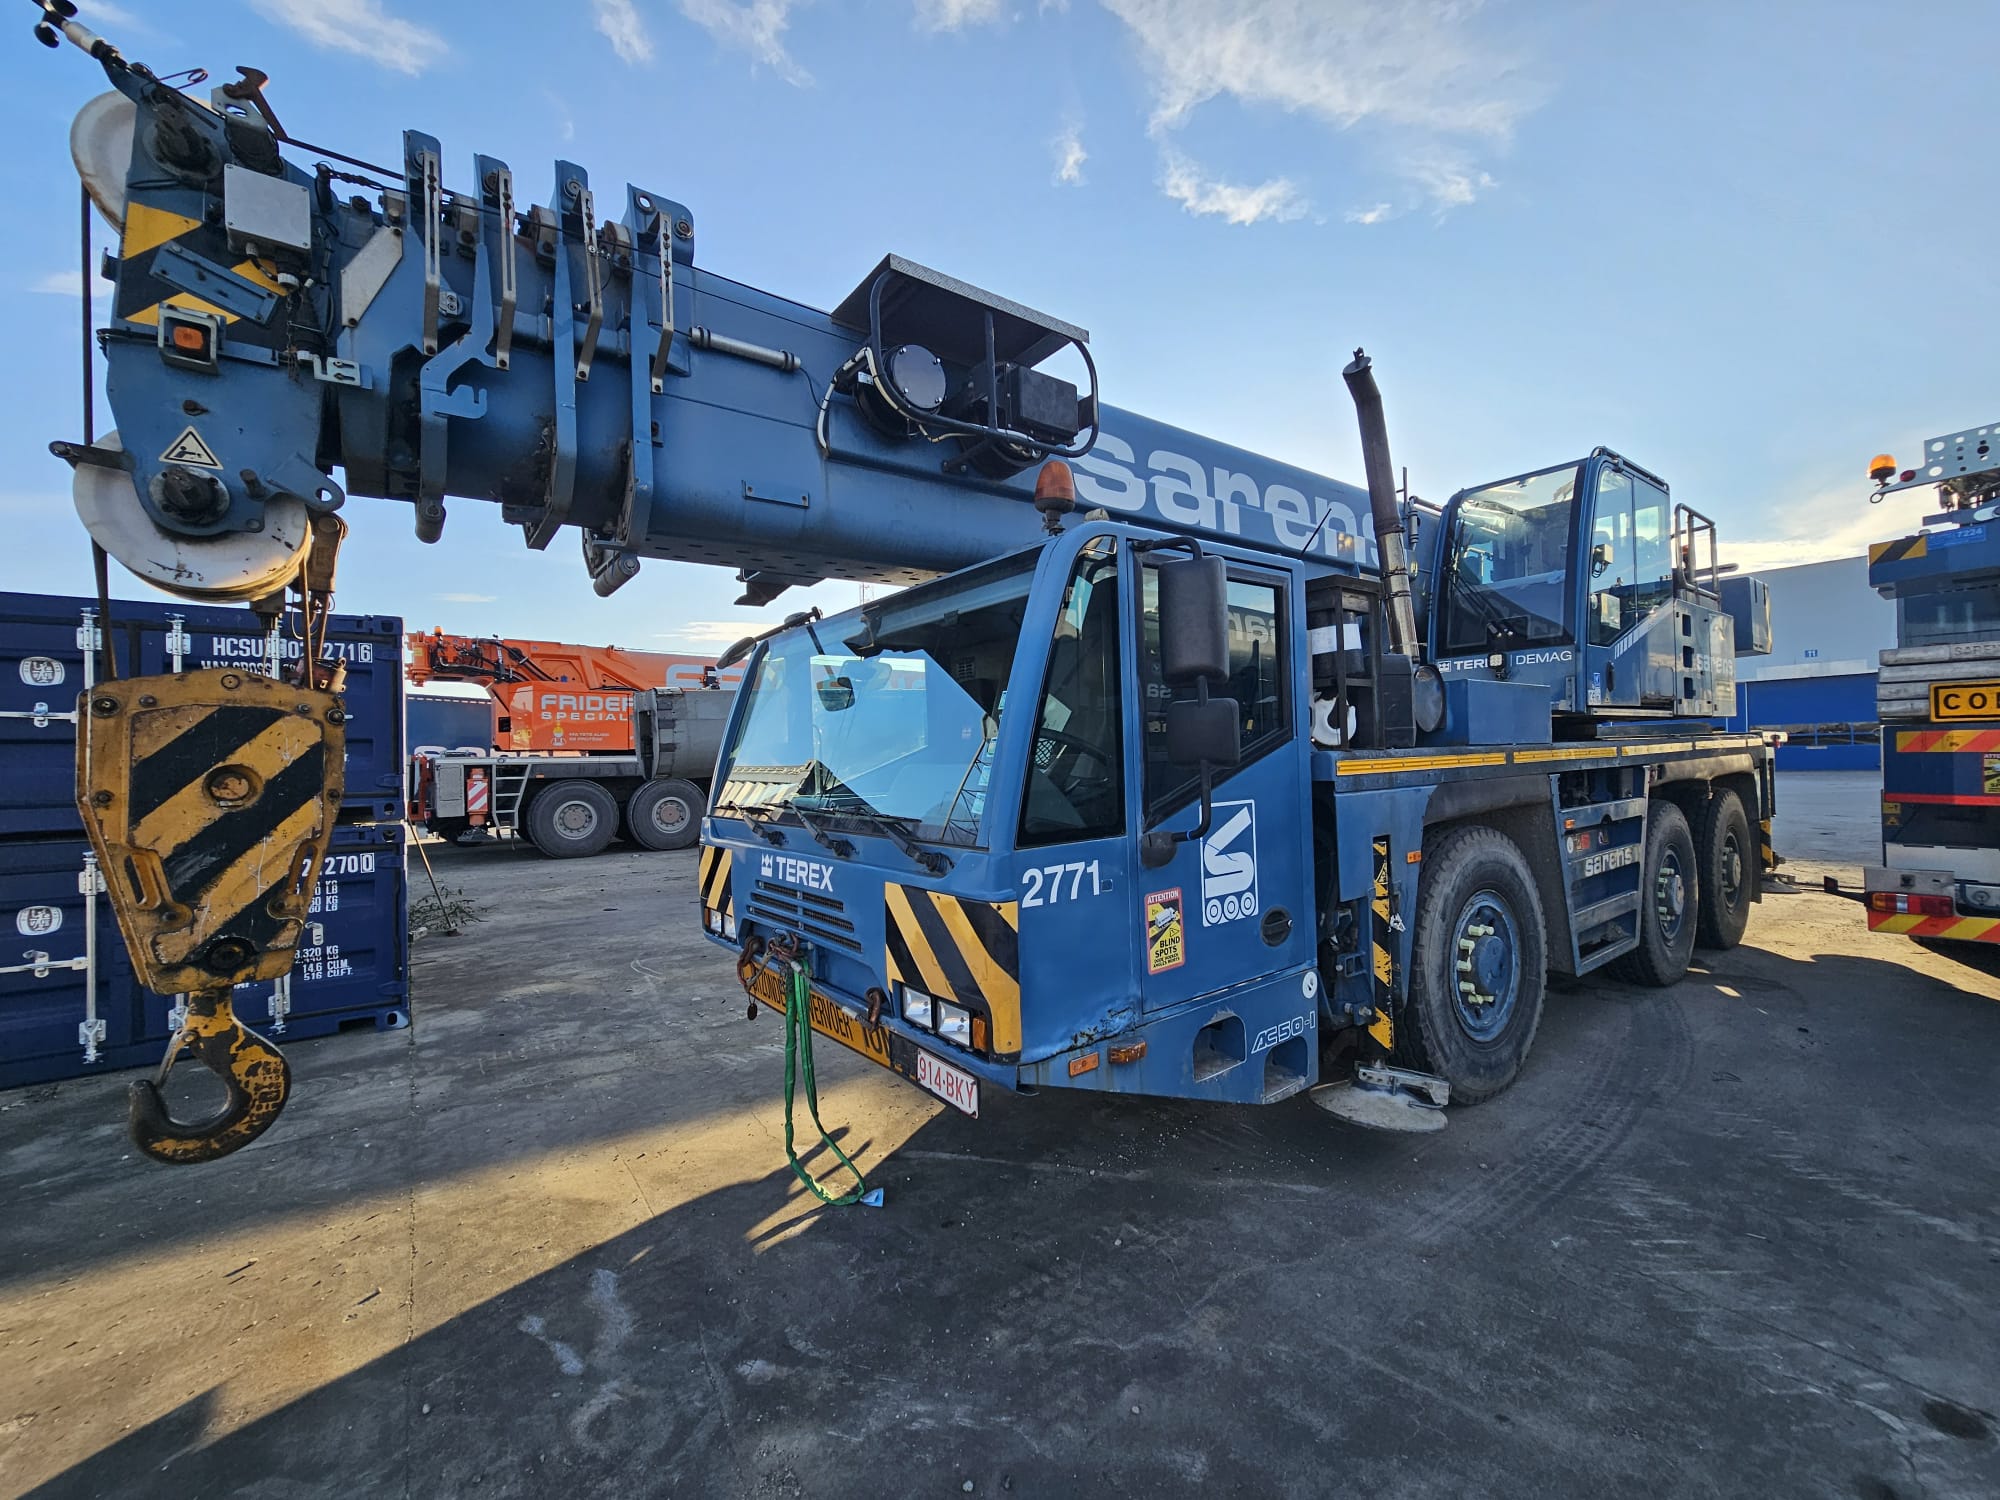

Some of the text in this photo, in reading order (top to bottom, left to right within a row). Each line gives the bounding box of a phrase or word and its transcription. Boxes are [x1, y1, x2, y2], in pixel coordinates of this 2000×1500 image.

[212, 637, 264, 657] HCSU
[1515, 650, 1572, 665] DEMAG
[1584, 847, 1633, 877] sarens
[776, 855, 834, 892] TEREX
[1021, 859, 1100, 909] 2771
[1148, 890, 1178, 905] ATTENTION
[1159, 936, 1181, 948] BLIND
[1155, 946, 1177, 959] SPOTS
